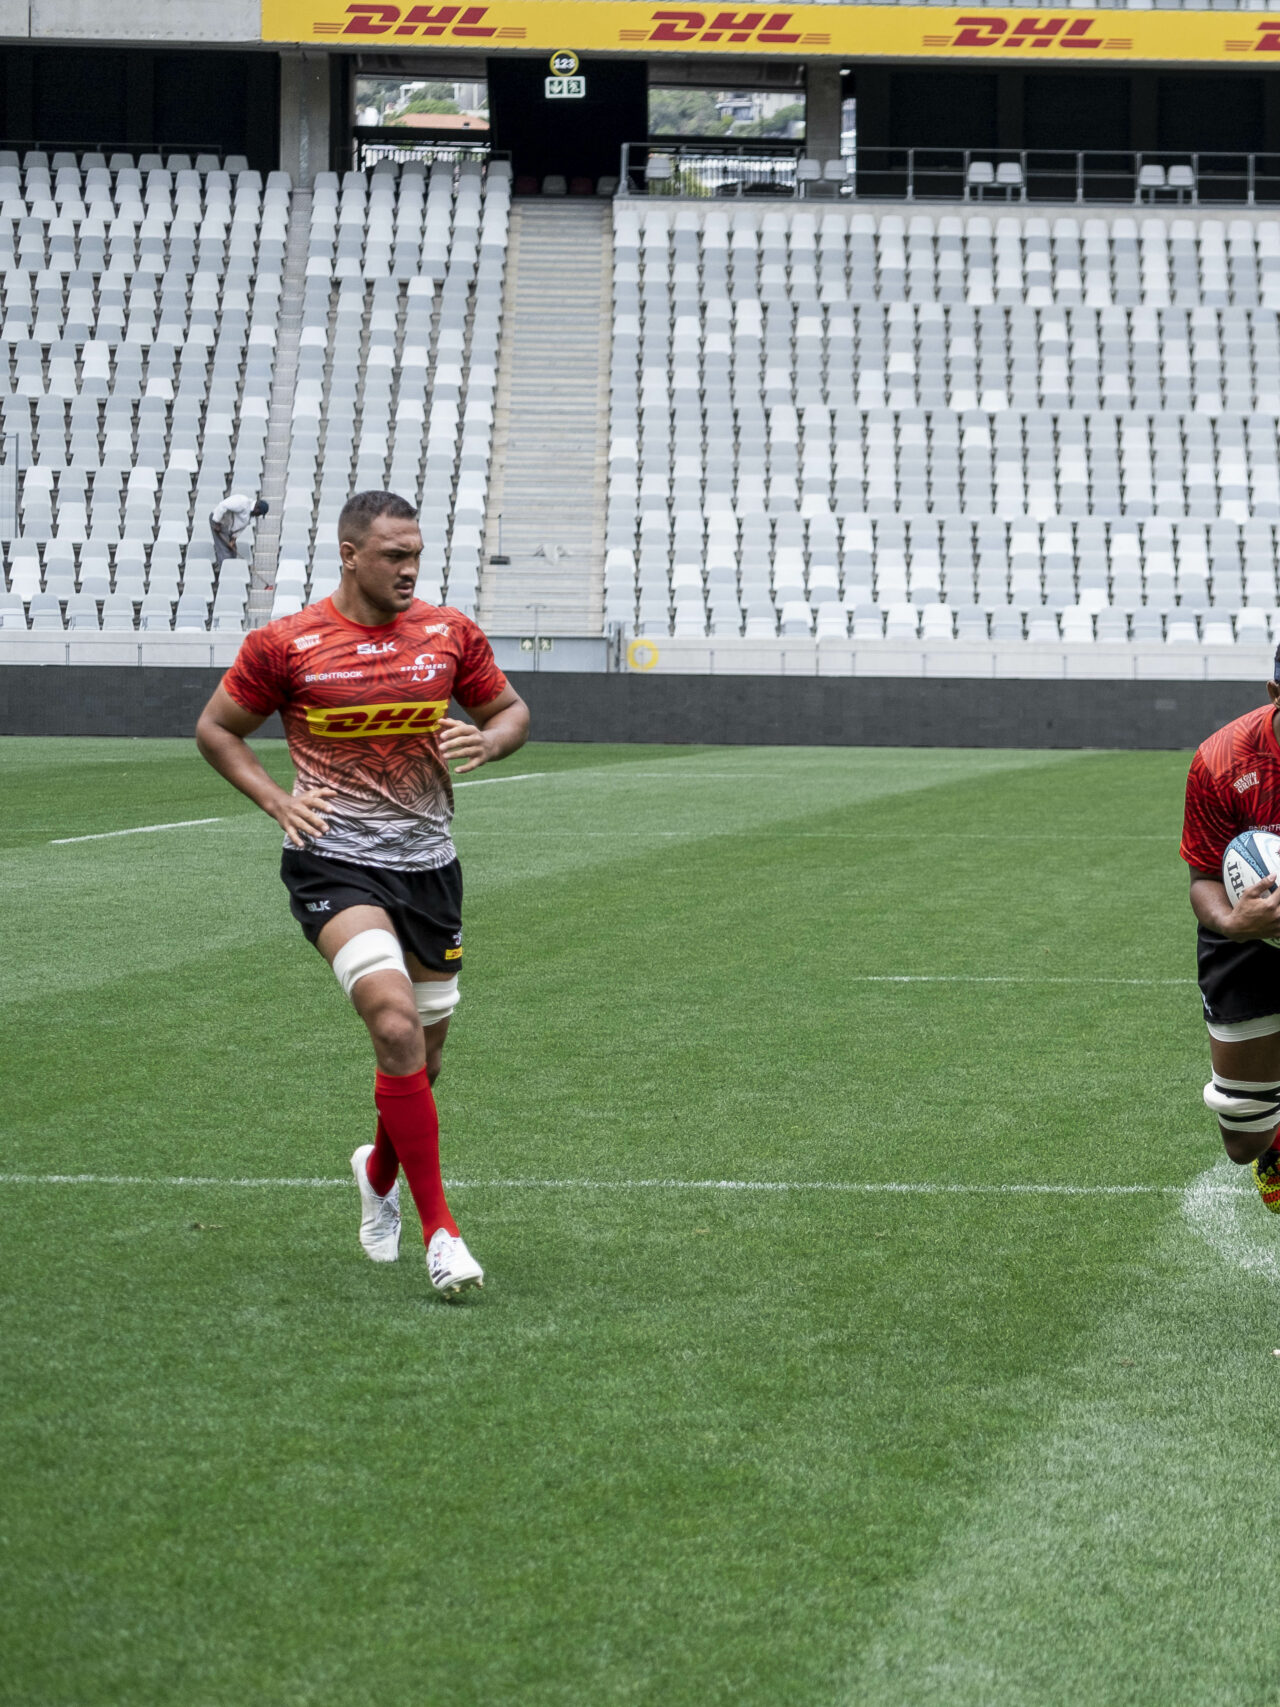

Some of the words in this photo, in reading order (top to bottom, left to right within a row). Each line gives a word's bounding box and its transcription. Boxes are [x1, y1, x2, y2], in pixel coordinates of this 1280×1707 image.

[342, 4, 498, 37] DHL
[648, 11, 802, 43] DHL
[952, 17, 1104, 48] DHL
[356, 641, 397, 655] BLK
[324, 707, 437, 732] DHL
